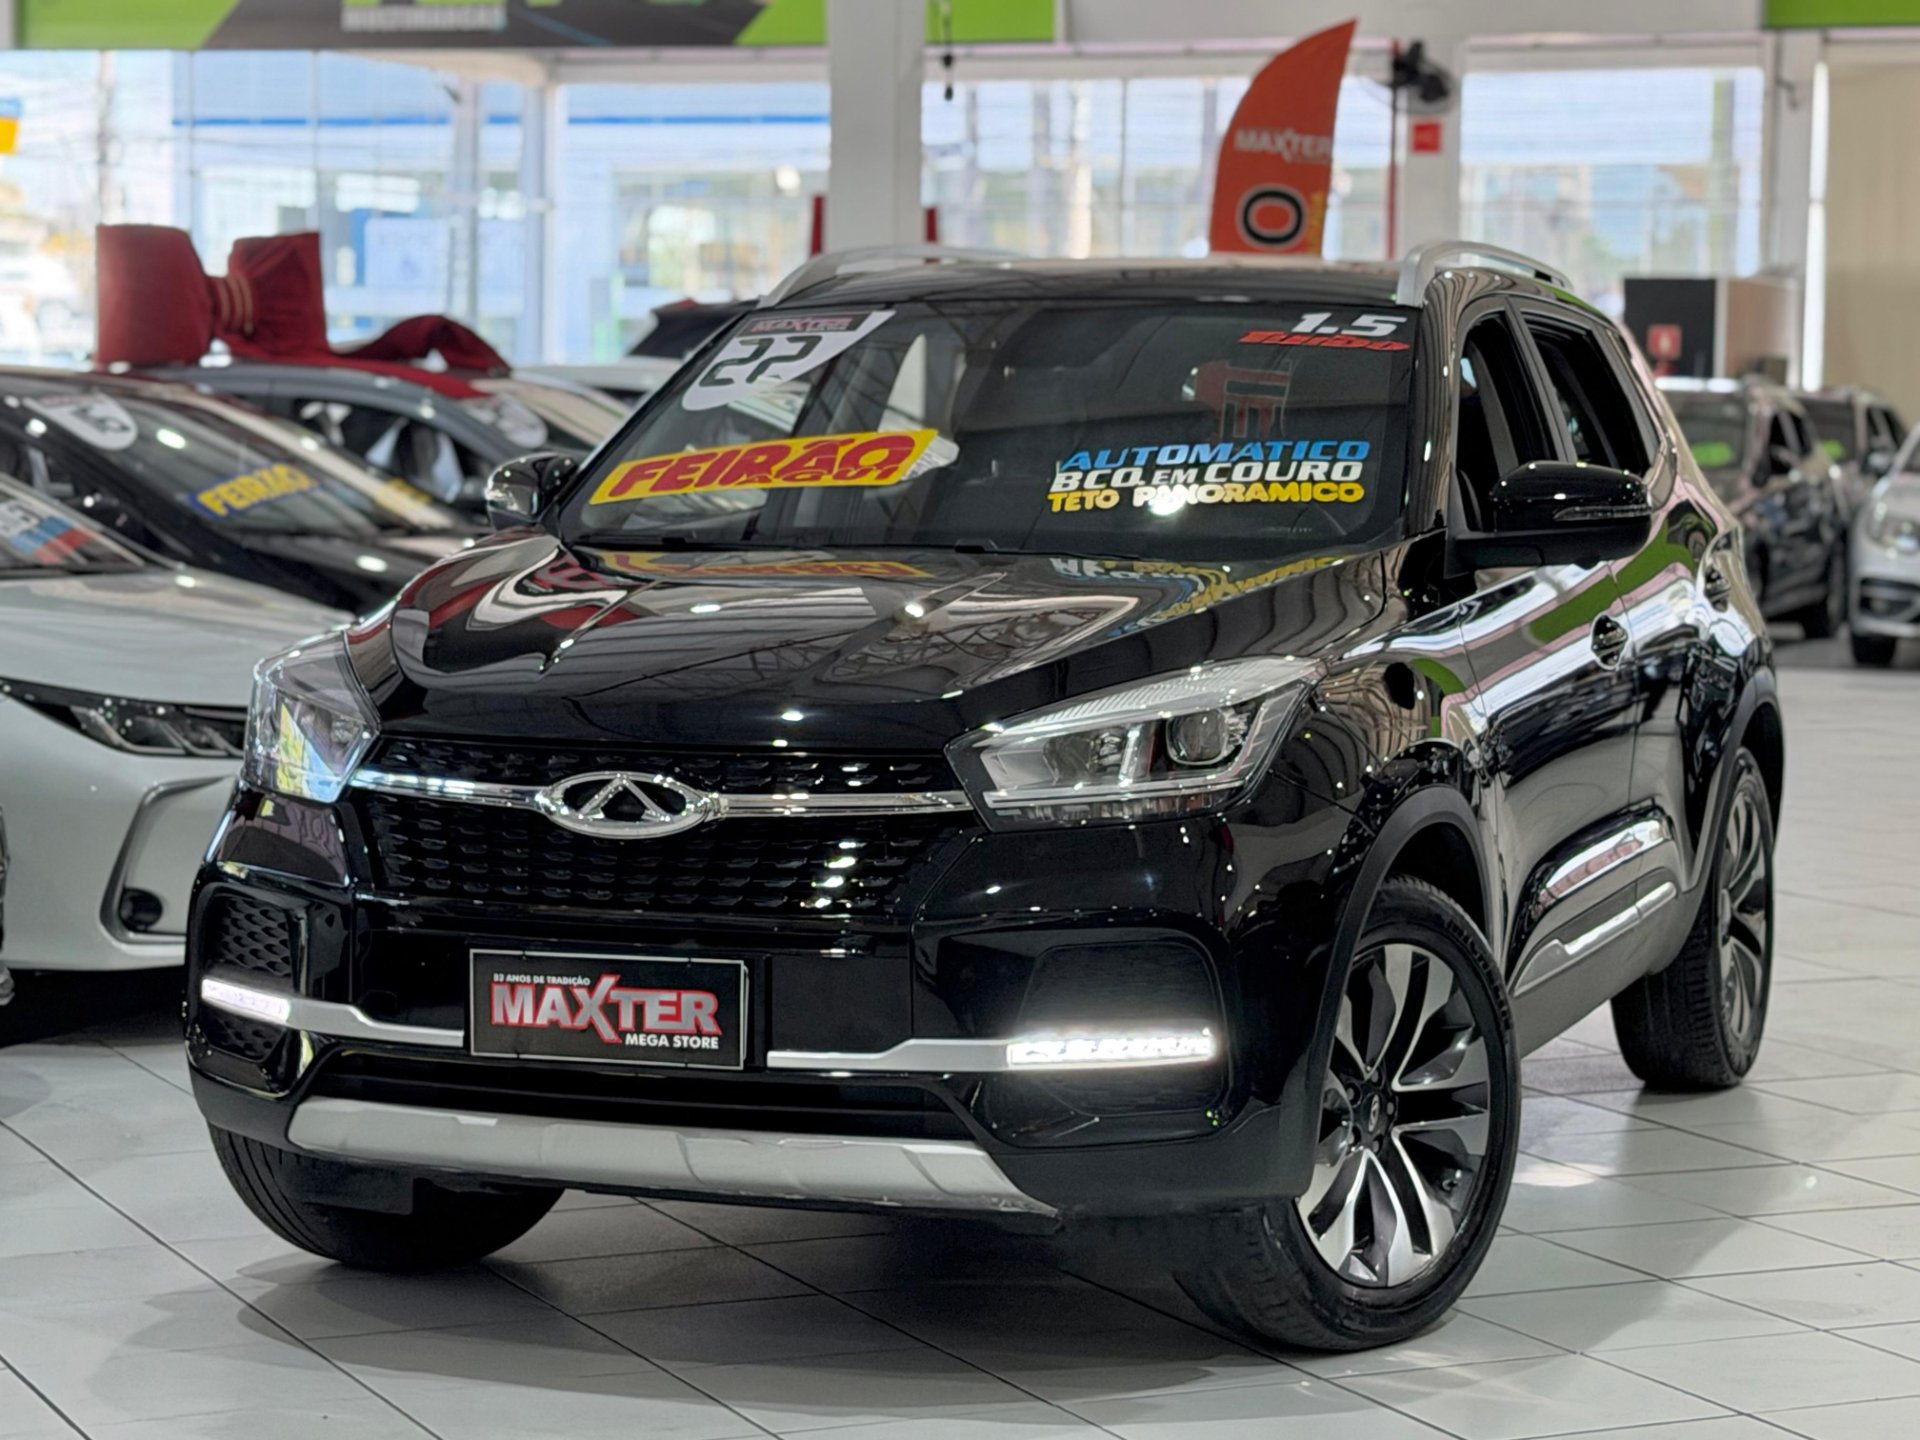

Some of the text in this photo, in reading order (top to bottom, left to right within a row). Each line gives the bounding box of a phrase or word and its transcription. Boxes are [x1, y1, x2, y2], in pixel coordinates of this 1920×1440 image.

[1292, 312, 1407, 337] 1.5
[699, 335, 822, 387] 22
[608, 434, 916, 496] FEIRÃO
[1059, 440, 1370, 471] AUTOMATICO
[1151, 469, 1196, 485] EM
[1203, 461, 1363, 482] COURO
[1048, 489, 1120, 512] TETO
[506, 974, 532, 983] ANOS
[533, 975, 544, 984] DE
[491, 974, 722, 1043] MAXTER
[625, 1033, 719, 1049] MEGA STORE
